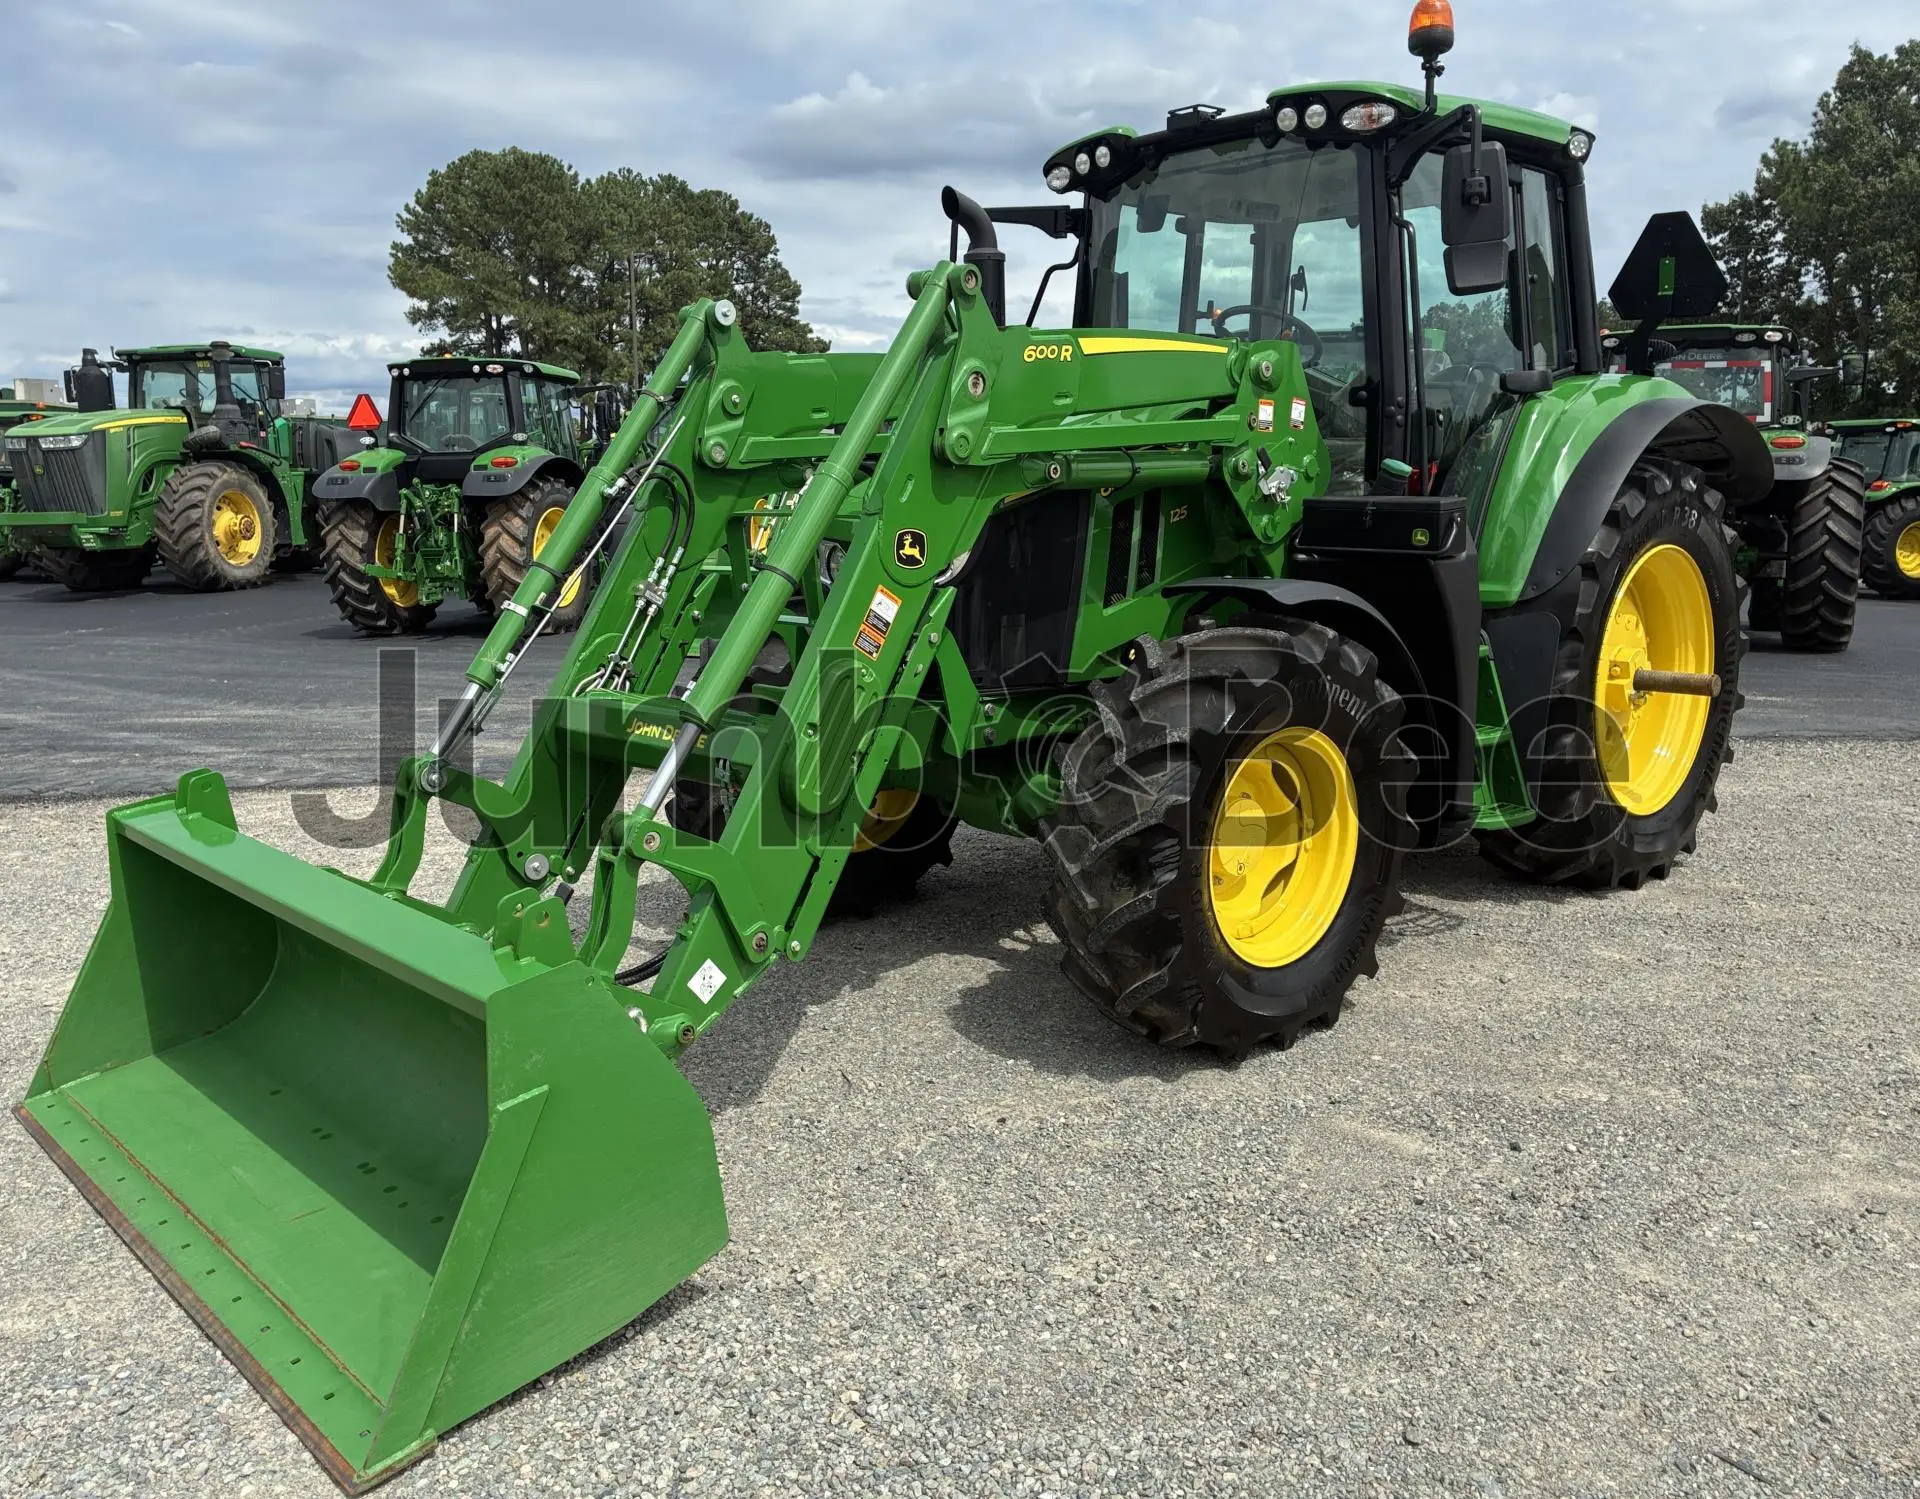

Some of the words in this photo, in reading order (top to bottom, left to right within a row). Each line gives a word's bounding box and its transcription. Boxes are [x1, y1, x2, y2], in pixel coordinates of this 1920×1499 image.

[1169, 504, 1189, 524] 125
[626, 717, 662, 739] JOHN
[662, 724, 708, 749] DEE
